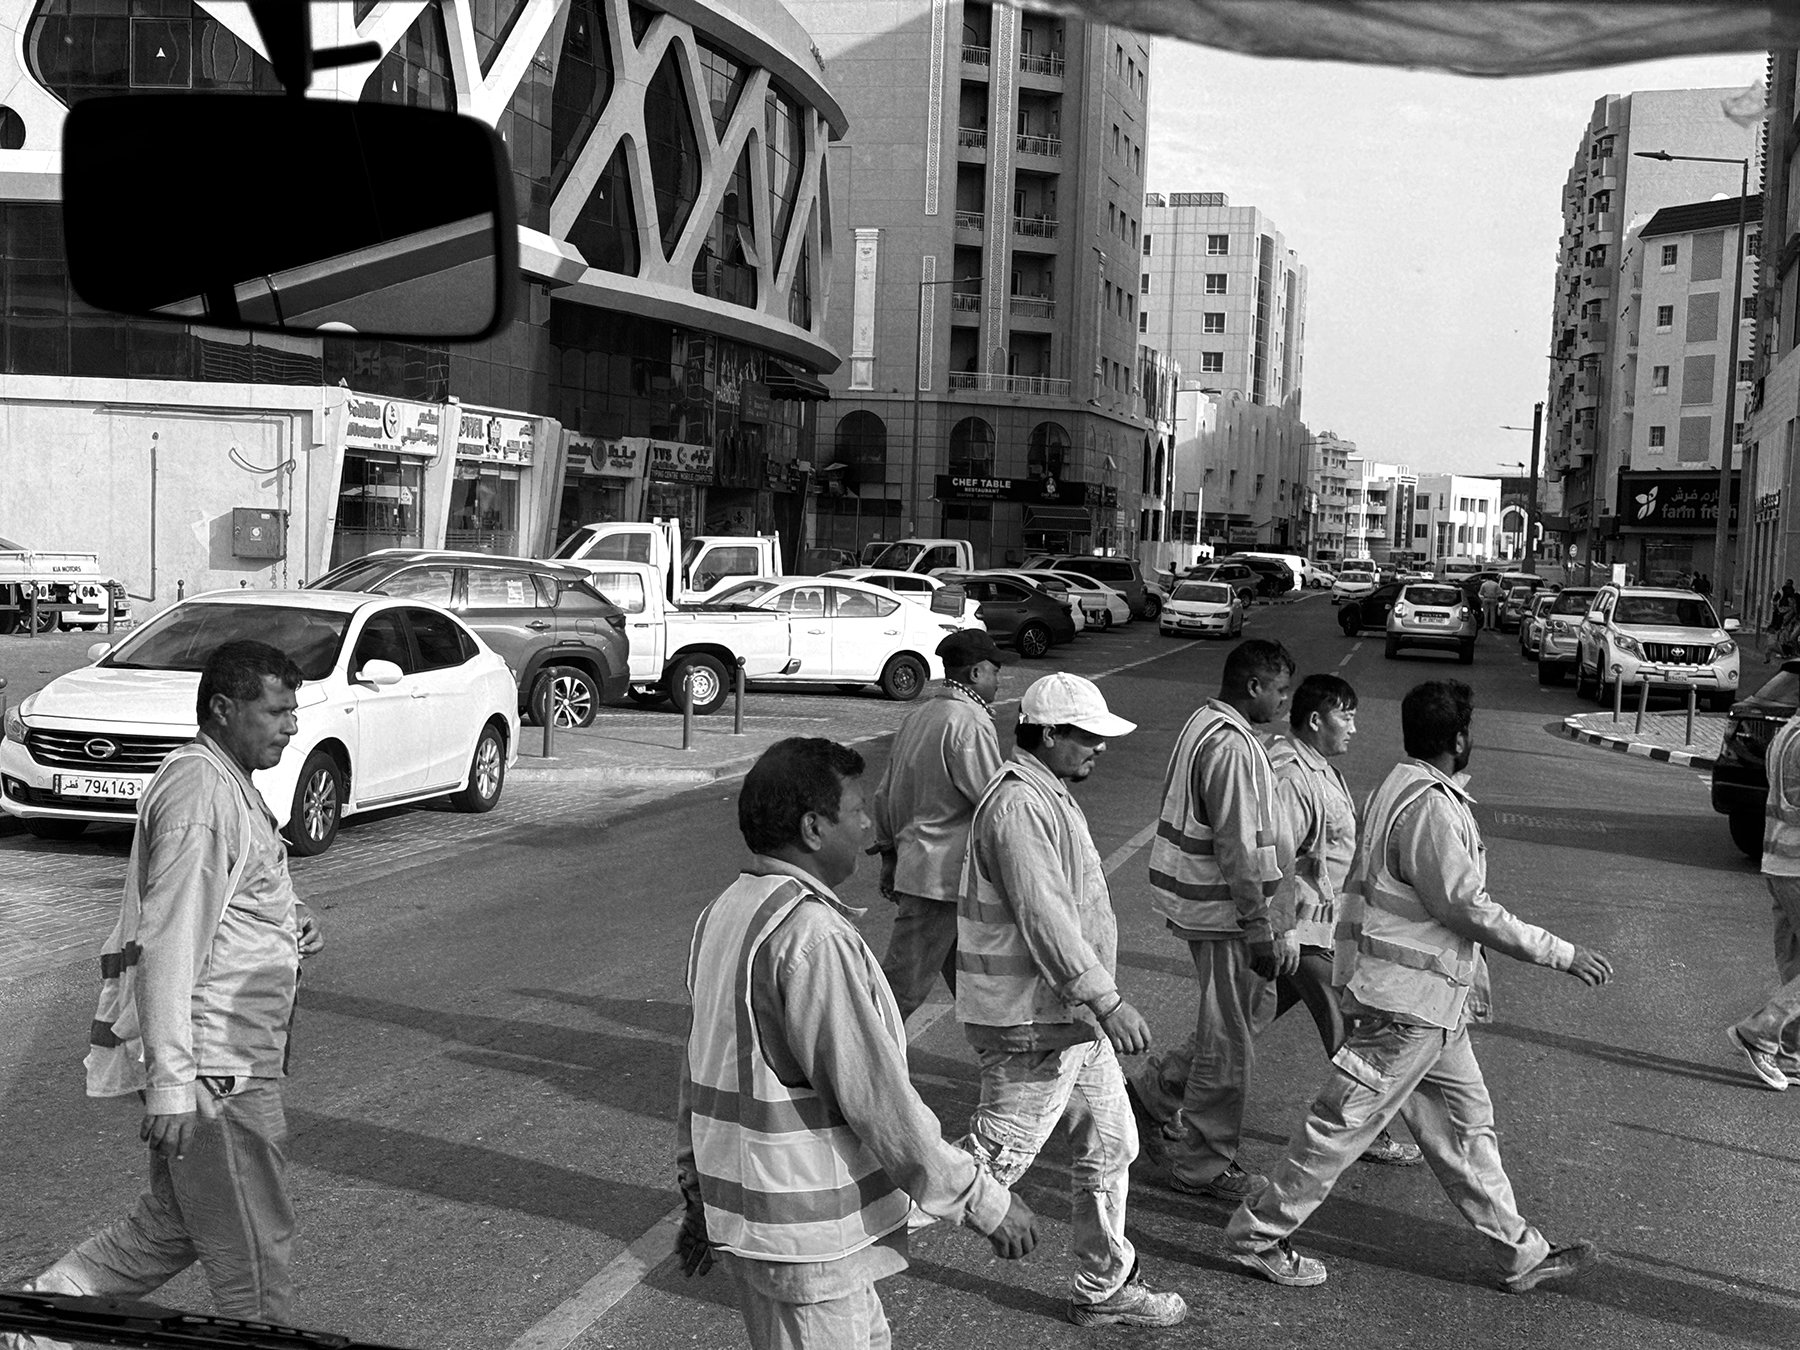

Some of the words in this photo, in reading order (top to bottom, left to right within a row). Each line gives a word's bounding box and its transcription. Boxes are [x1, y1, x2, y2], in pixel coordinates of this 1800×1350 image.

[952, 477, 979, 487] CHEF
[980, 479, 1011, 489] TABLE
[1671, 487, 1698, 502] فرش
[1700, 490, 1720, 502] ارم
[1661, 503, 1695, 519] farm
[1701, 503, 1737, 519] freh
[62, 779, 79, 791] قطر
[84, 779, 135, 796] 794143
